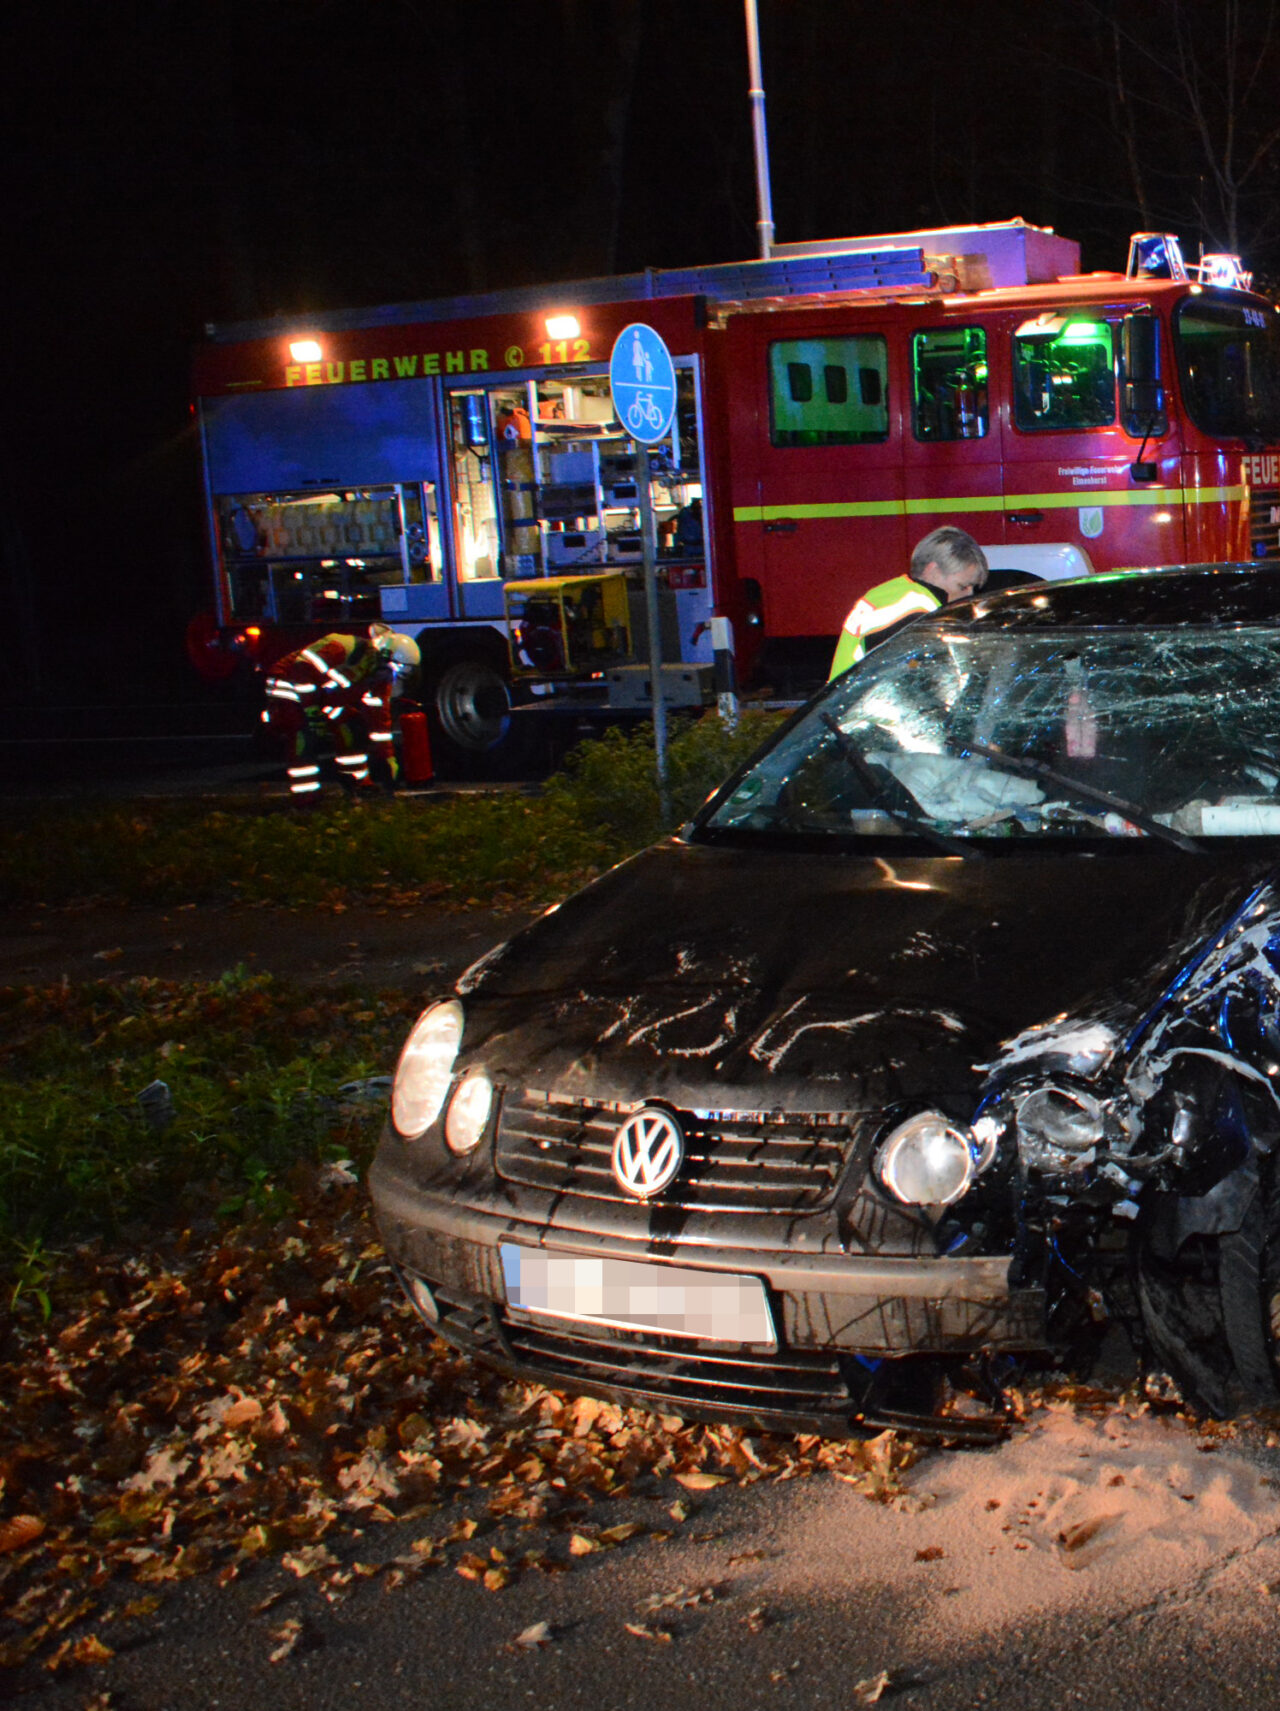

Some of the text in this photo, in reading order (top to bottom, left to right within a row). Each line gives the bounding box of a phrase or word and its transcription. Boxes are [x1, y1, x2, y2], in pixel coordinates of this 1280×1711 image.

[286, 340, 591, 387] FEUERWEHR 112
[613, 1109, 682, 1195] VW
